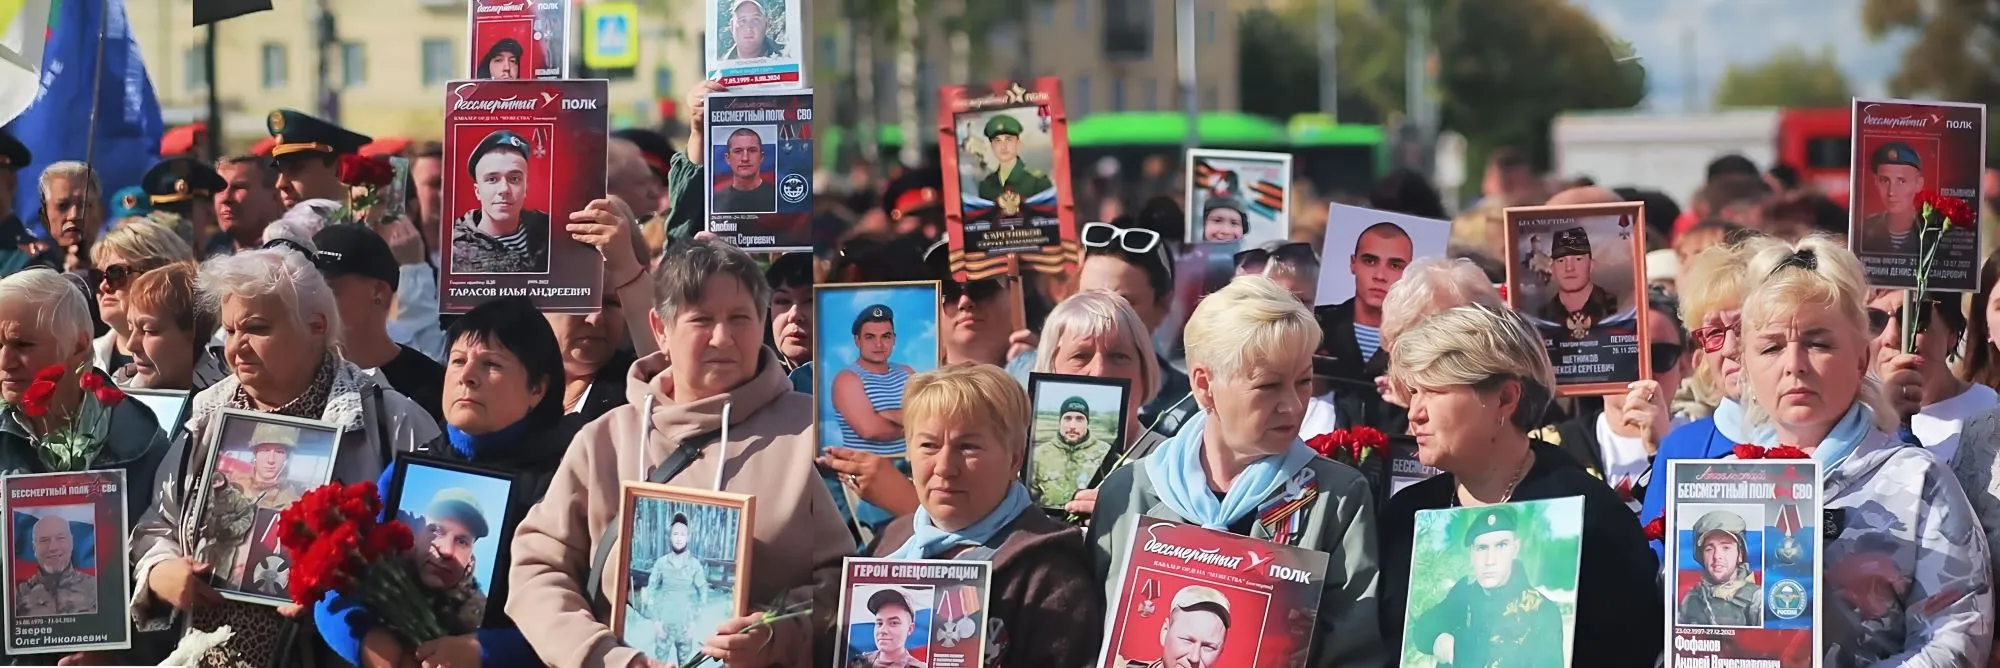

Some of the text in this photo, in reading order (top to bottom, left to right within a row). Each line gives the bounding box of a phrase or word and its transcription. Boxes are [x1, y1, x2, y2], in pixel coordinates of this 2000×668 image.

[562, 99, 597, 110] ПОЛК
[712, 108, 812, 122] БЕССМЕРТНЫЙ ПОЛК СВО
[1946, 120, 1973, 129] ПОЛК
[711, 220, 737, 232] Злобин
[737, 233, 776, 246] Сергеевич
[1890, 267, 1912, 277] ДЕНИС
[449, 288, 591, 297] ТАРАСОВ ИЛЬЯ АНДРЕЕВИЧ
[1578, 364, 1615, 373] СЕРГЕЕВИЧ
[11, 484, 117, 498] БЕССМЕРТНЫЙ ПОЛК СВО
[1678, 481, 1812, 499] БЕССМЕРТНЫЙ ПОЛК СВО
[853, 564, 979, 580] ГЕРОИ СПЕЦОПЕРАЦИИ
[1269, 564, 1312, 585] ПОЛК
[15, 627, 53, 636] Зверев
[15, 634, 108, 646] Олег Николаевич
[1675, 635, 1721, 654] Фофанов
[1675, 653, 1711, 668] Андрей
